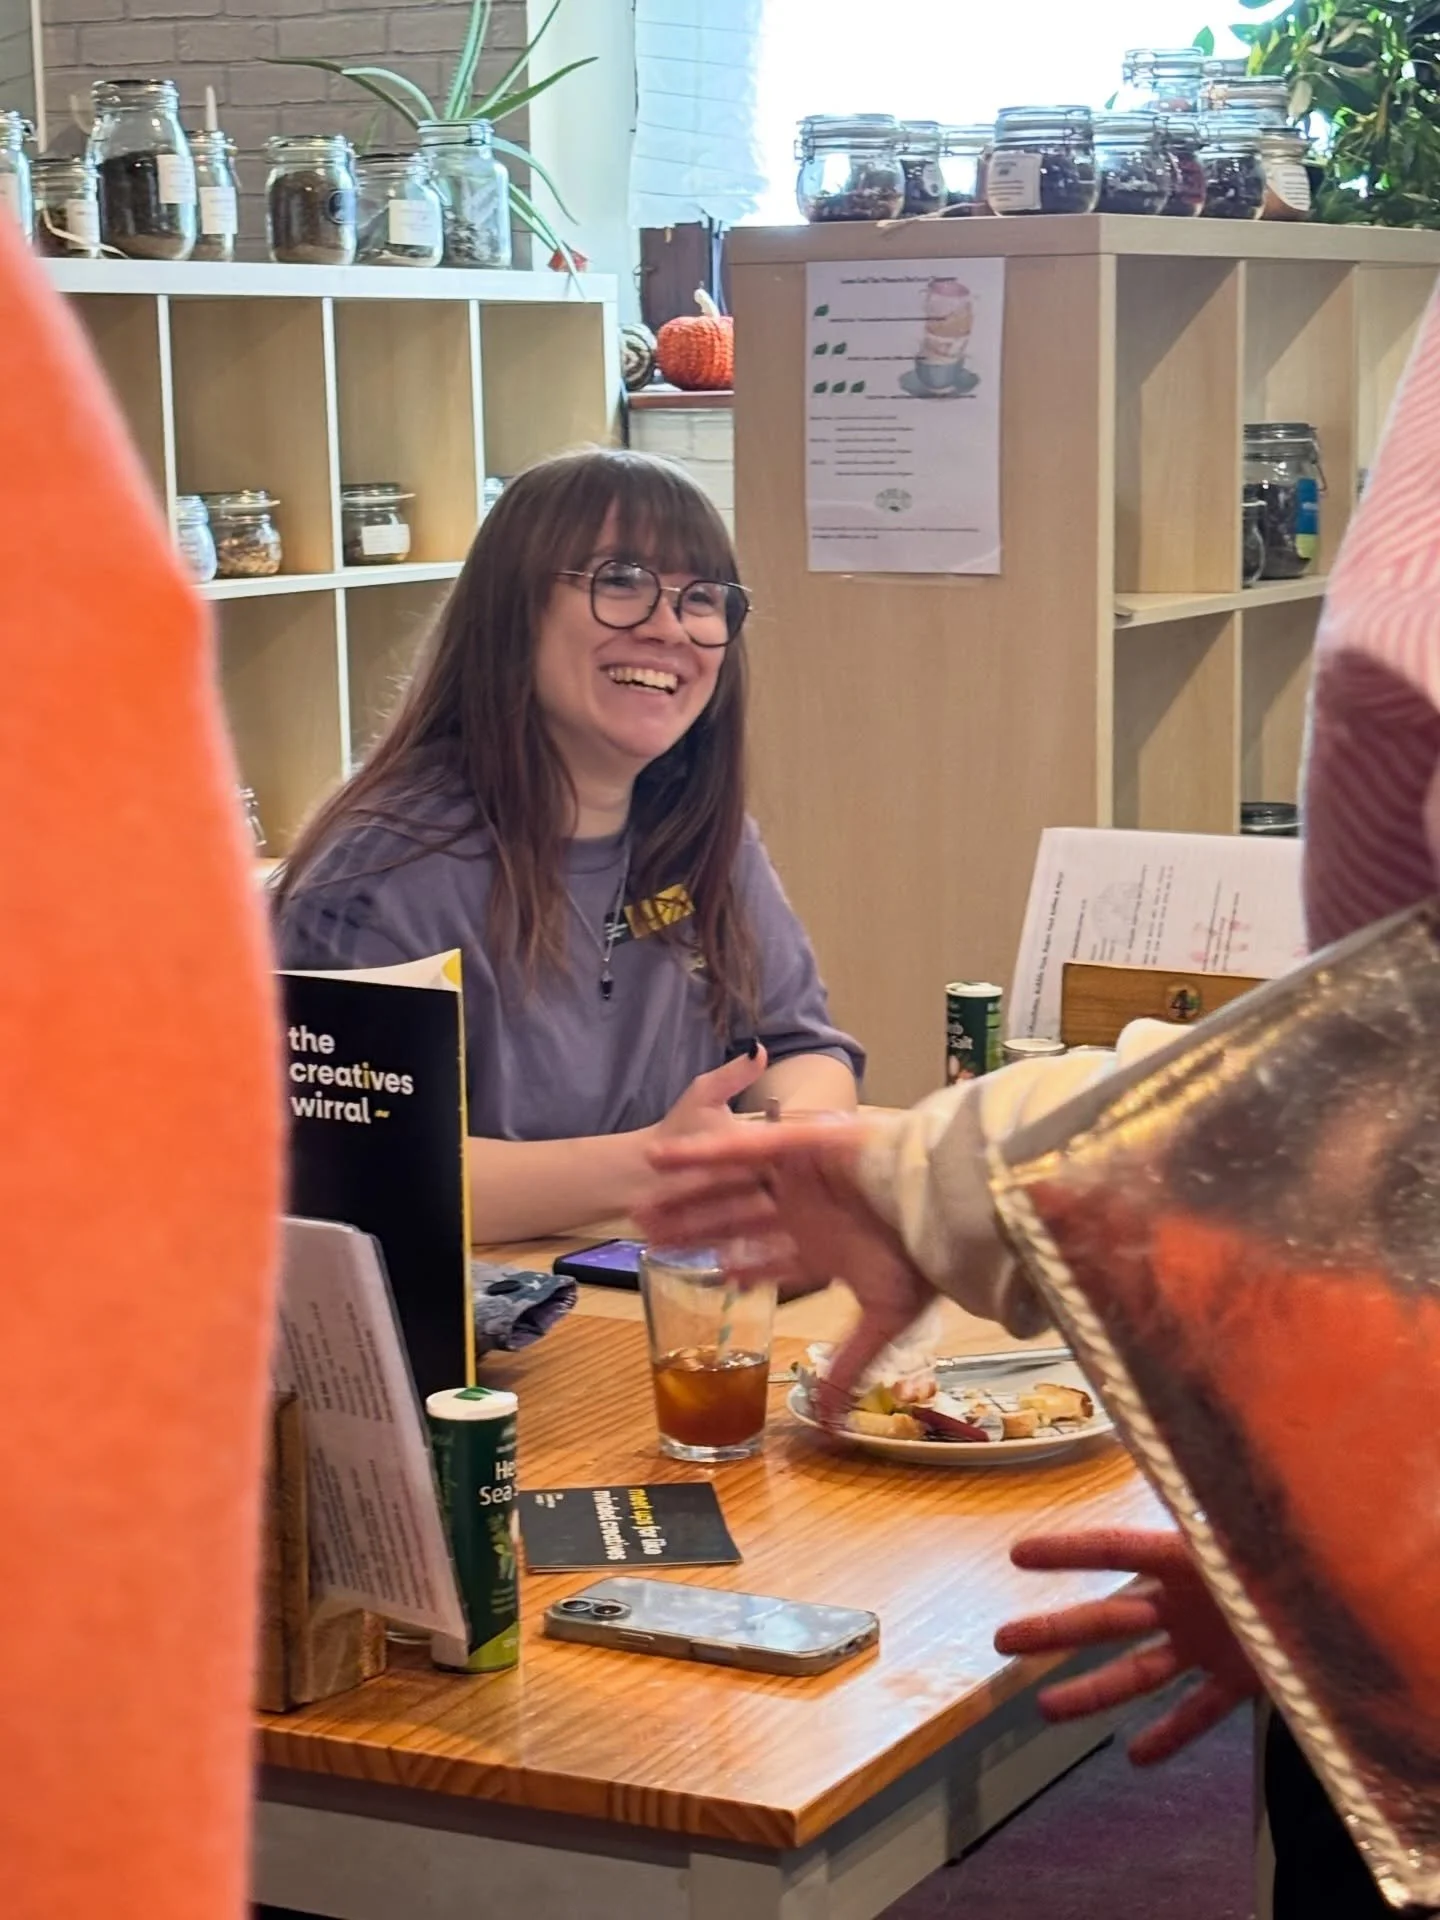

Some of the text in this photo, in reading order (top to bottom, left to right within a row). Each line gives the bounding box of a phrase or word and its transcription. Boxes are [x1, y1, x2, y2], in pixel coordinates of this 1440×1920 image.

[288, 1024, 336, 1054] the
[289, 1061, 414, 1095] creatives
[290, 1090, 372, 1124] wirral
[592, 1490, 630, 1560] minded creatives
[628, 1488, 667, 1555] meet ups for like
